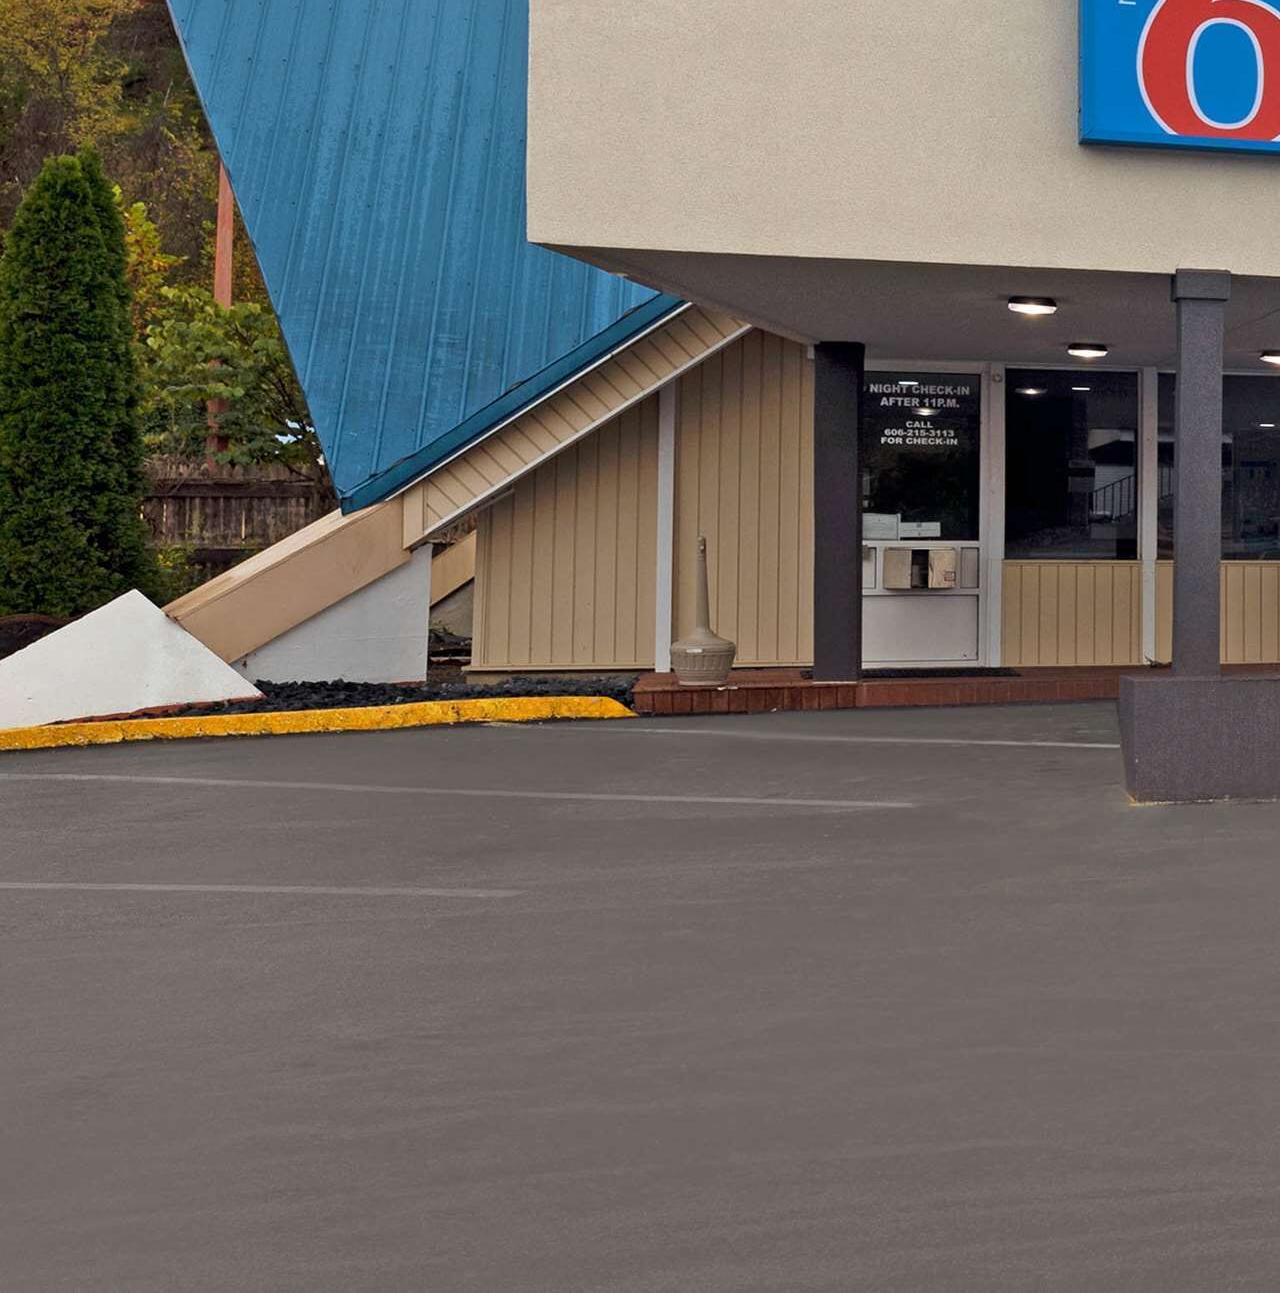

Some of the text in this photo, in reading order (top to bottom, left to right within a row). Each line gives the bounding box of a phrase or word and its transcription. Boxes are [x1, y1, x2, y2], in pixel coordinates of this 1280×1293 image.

[869, 383, 970, 395] NIGHT CHECK-IN
[879, 397, 920, 407] AFTER
[905, 421, 934, 429] CALL
[880, 437, 958, 446] FOR CHECK-IN
